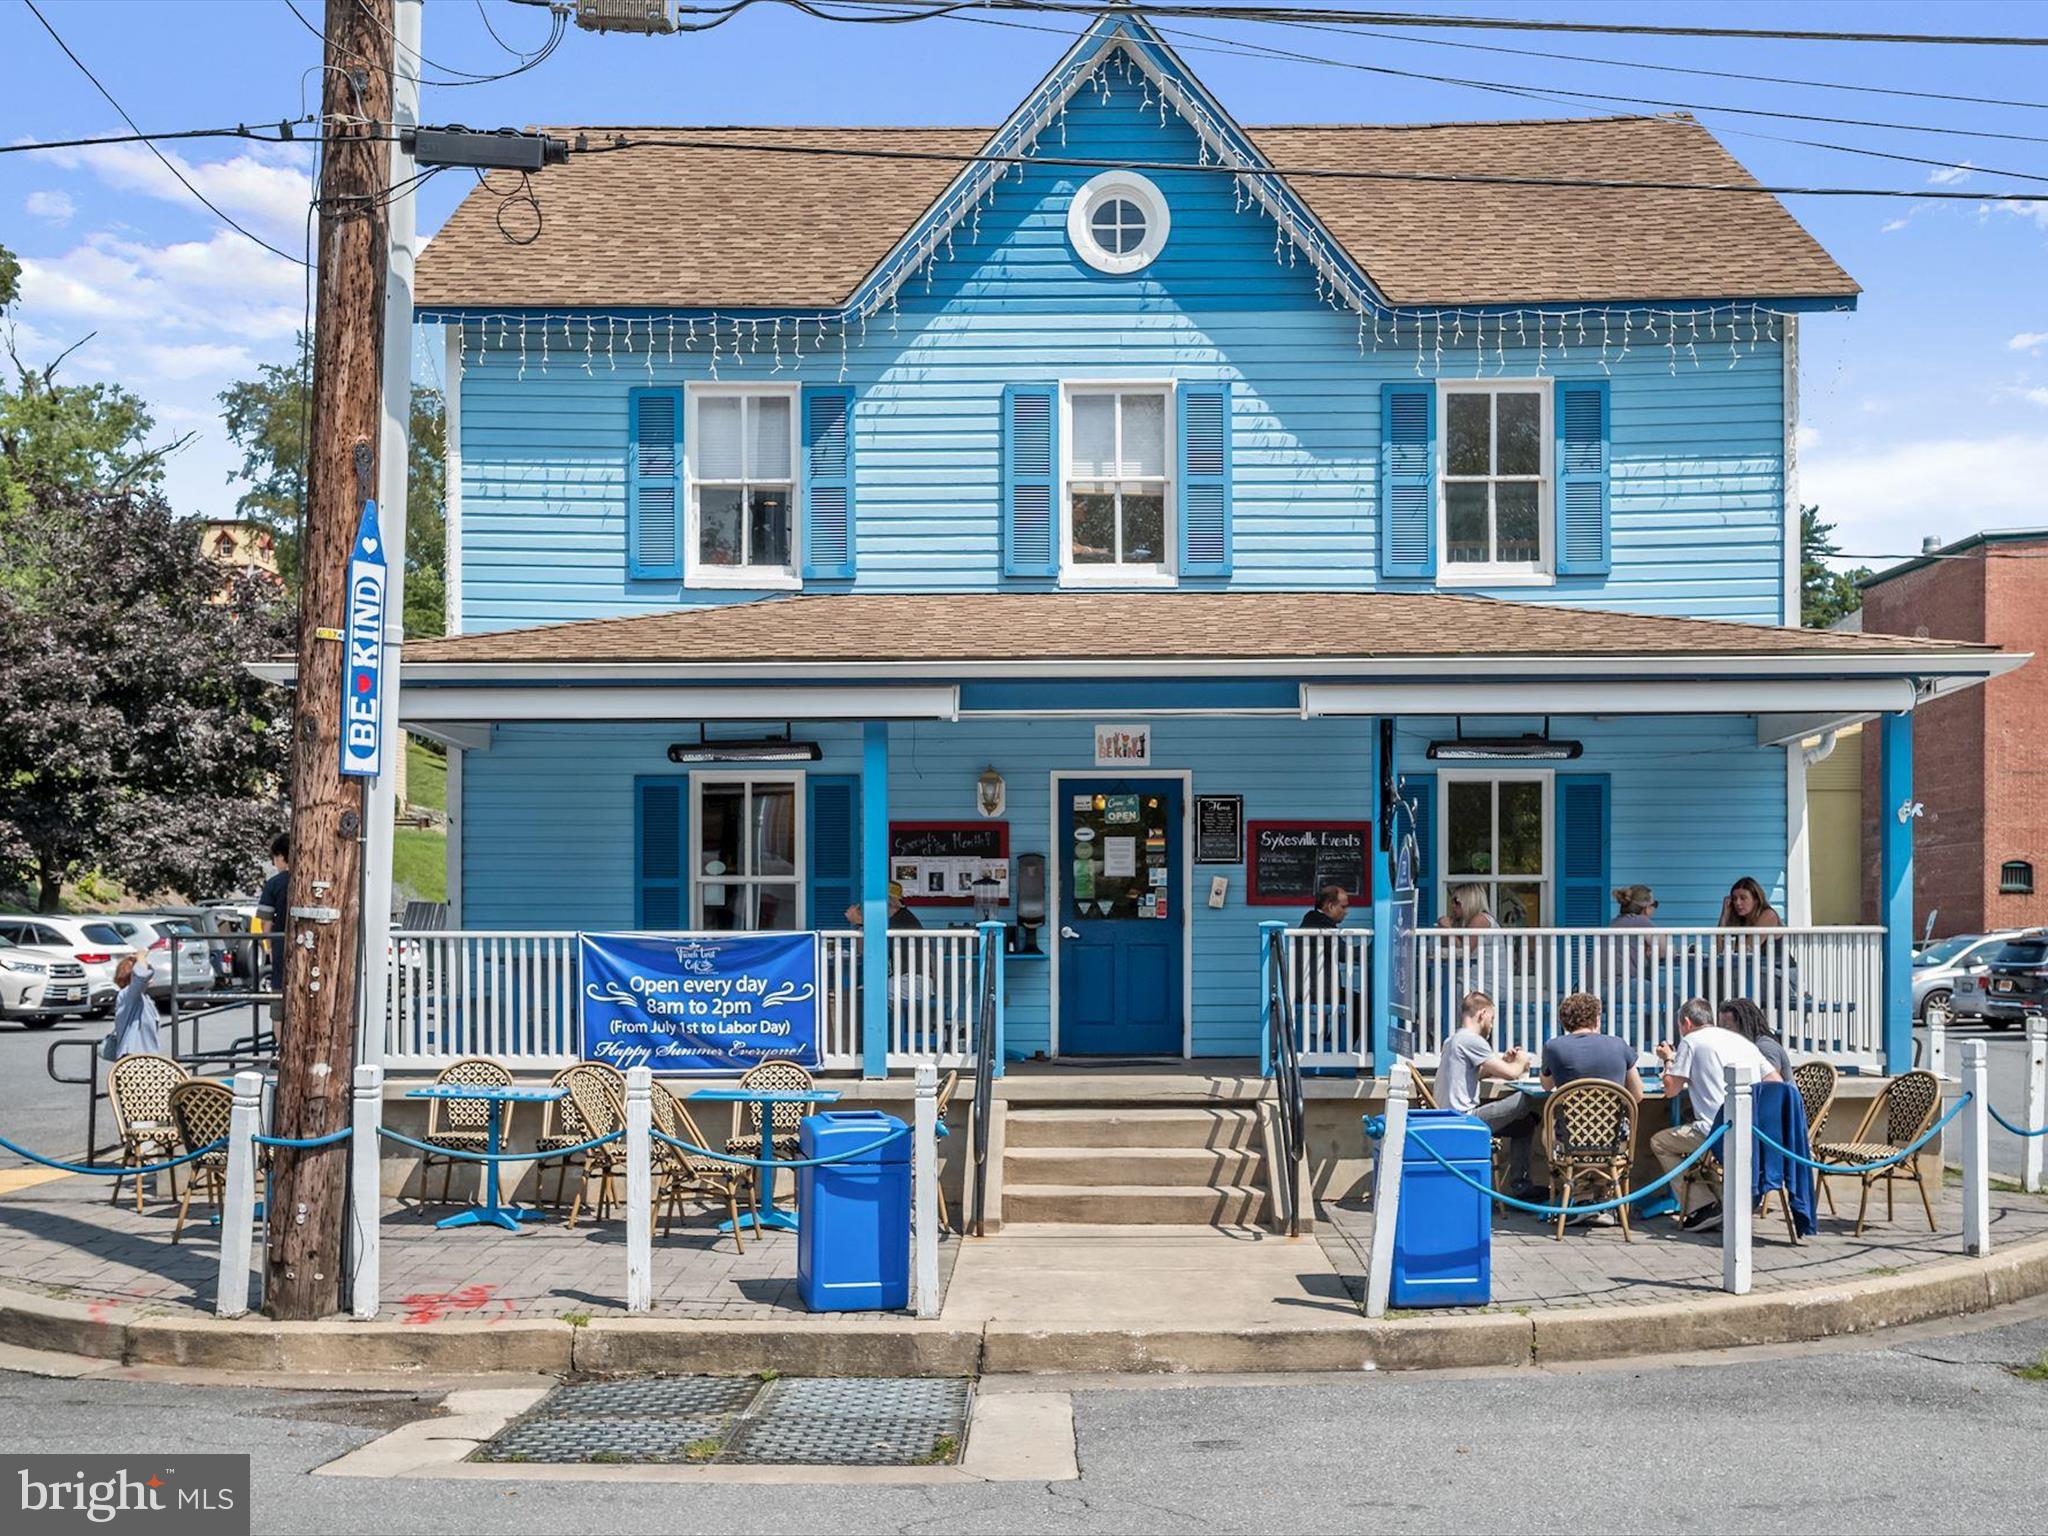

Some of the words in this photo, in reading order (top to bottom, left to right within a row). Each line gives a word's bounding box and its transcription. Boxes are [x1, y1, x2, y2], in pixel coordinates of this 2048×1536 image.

[352, 581, 381, 668] KIND
[349, 696, 376, 748] BE
[1108, 811, 1137, 821] OPEN
[1260, 830, 1318, 851] Sykesville
[1321, 832, 1361, 847] Events
[630, 975, 680, 994] Open
[683, 979, 732, 996] every
[735, 975, 768, 994] day
[647, 998, 684, 1015] 8am
[688, 999, 708, 1015] to
[712, 998, 751, 1018] 2pm
[610, 1020, 648, 1035] (From
[650, 1020, 677, 1036] July
[681, 1021, 699, 1035] 1st
[701, 1021, 716, 1034] to
[719, 1019, 757, 1035] Labor
[760, 1019, 791, 1036] Day)
[594, 1041, 652, 1067] Happy
[655, 1040, 724, 1058] Summer
[728, 1040, 805, 1065] Everyone!
